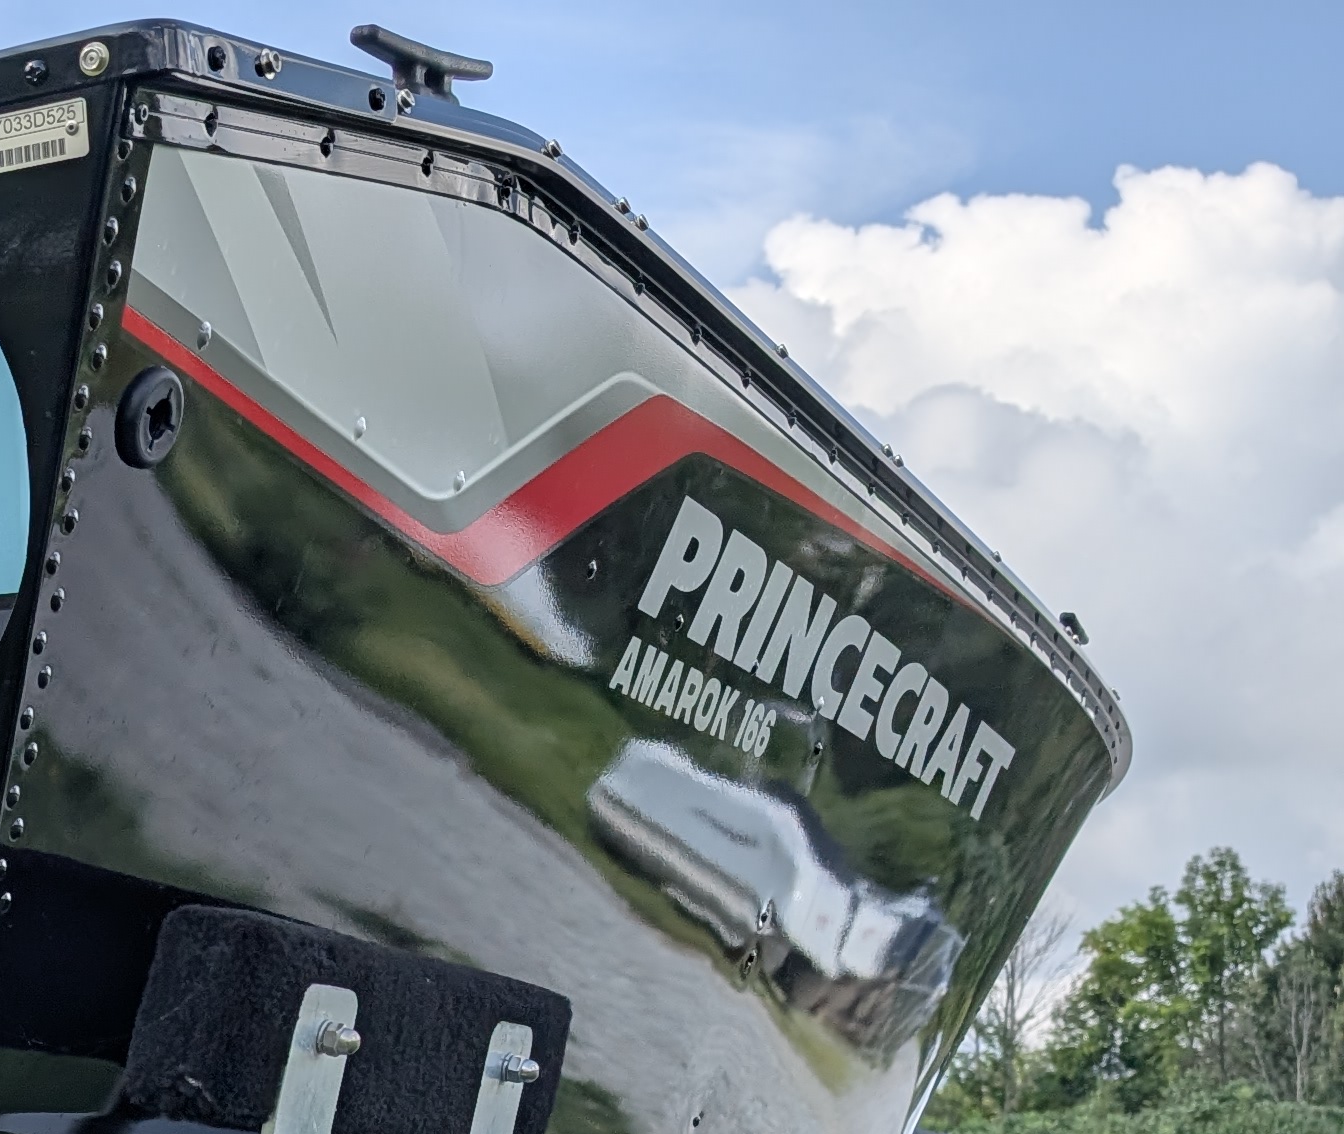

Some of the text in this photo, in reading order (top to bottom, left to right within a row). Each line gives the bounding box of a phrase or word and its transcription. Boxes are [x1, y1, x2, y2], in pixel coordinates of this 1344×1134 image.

[609, 635, 777, 759] AMAROK 166
[638, 495, 1016, 821] PRINCECRAFT
